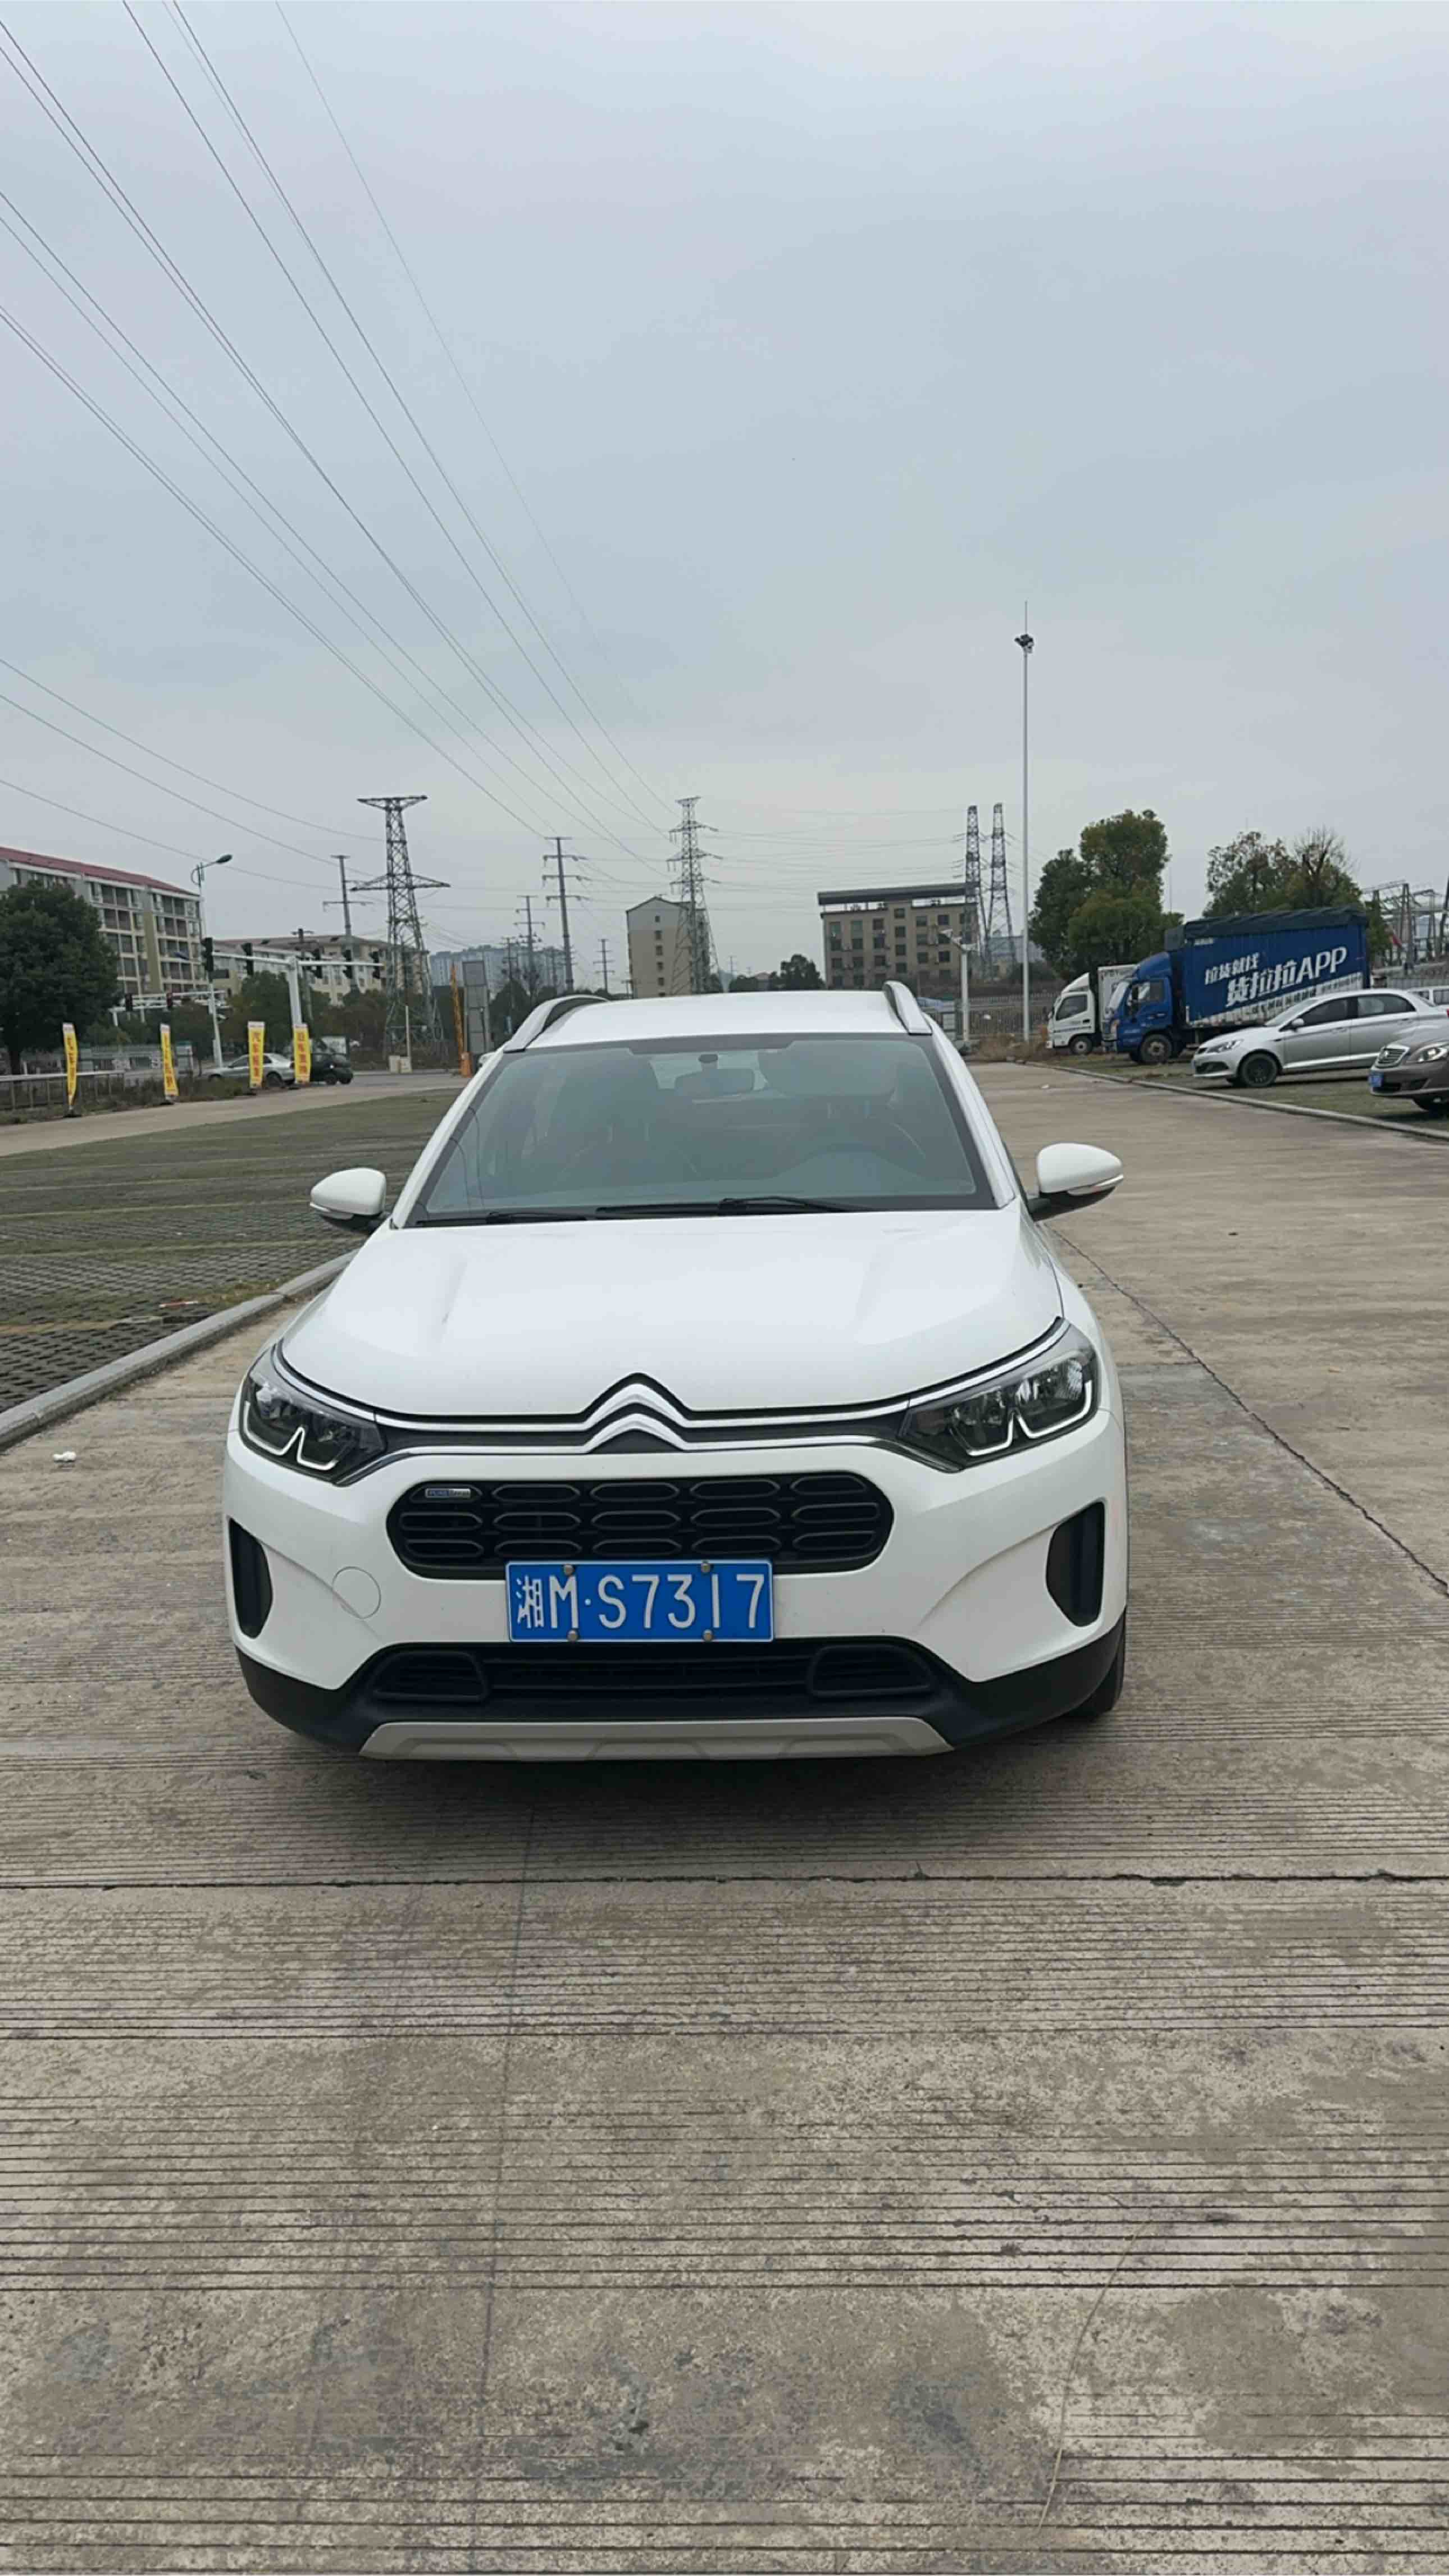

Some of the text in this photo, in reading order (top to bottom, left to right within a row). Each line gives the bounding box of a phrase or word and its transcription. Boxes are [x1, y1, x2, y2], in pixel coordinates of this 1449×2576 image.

[1225, 946, 1347, 1008] 货拉拉APP
[516, 1573, 765, 1629] 湘M·S7317
